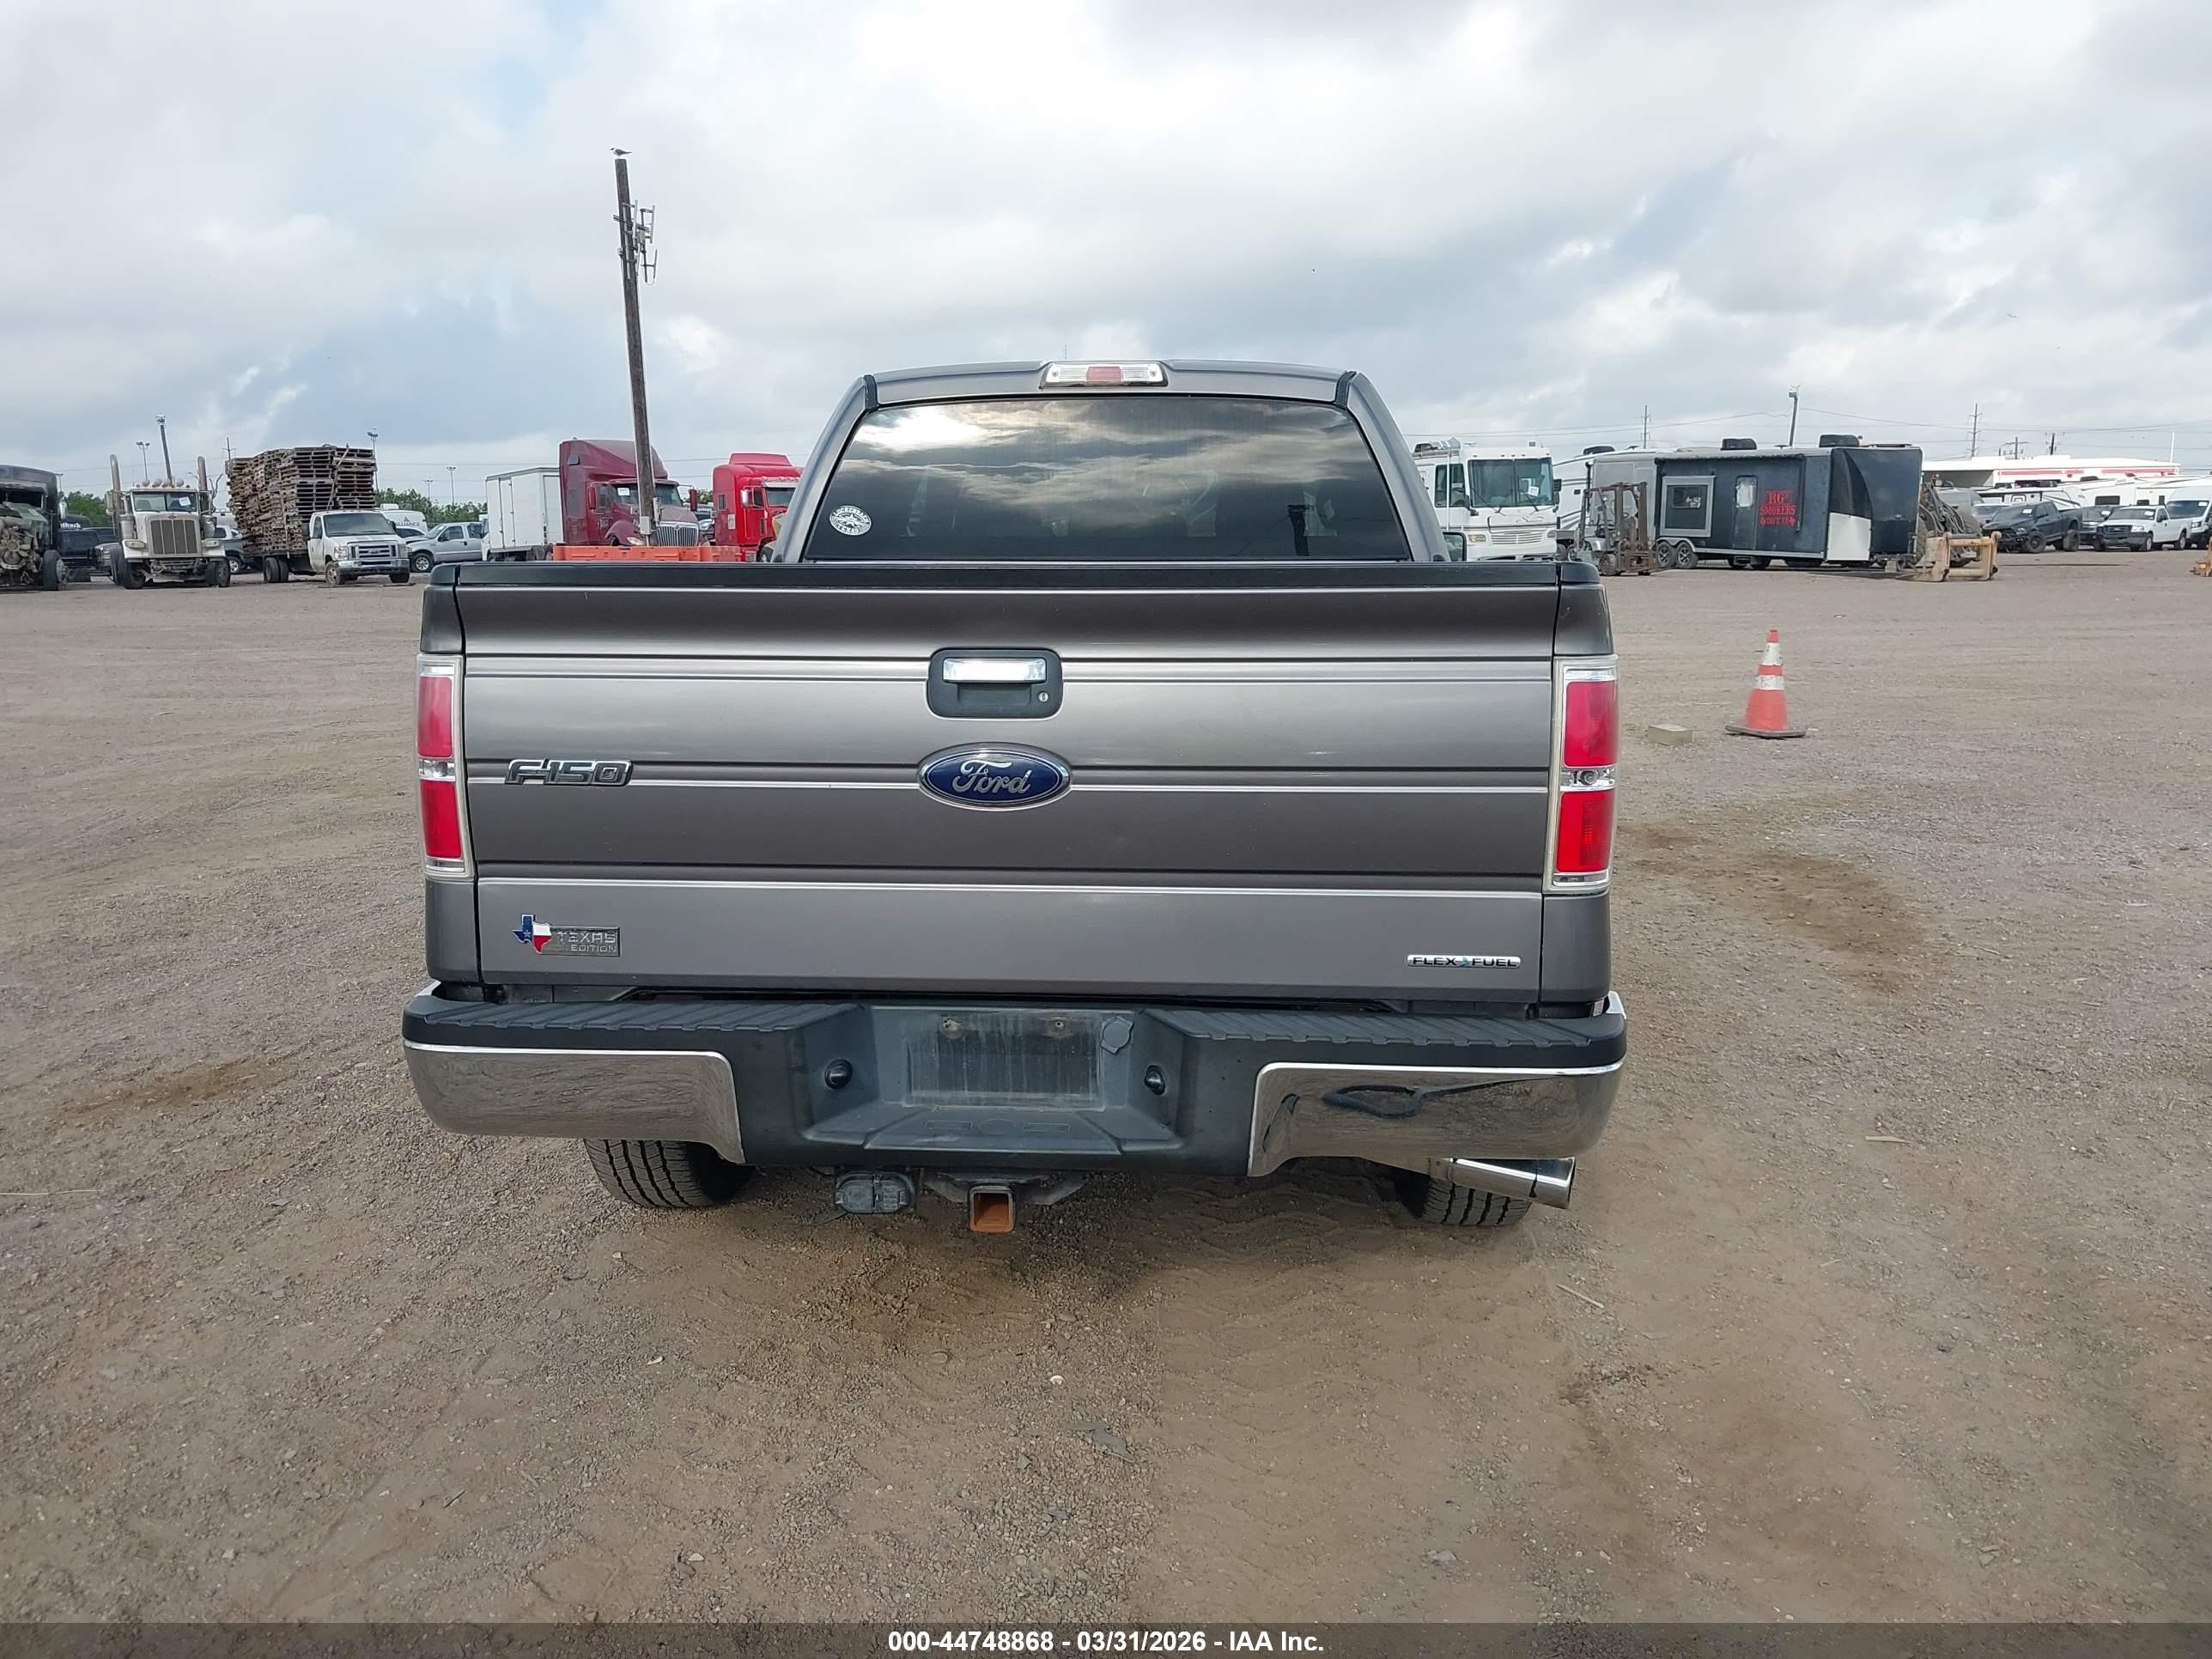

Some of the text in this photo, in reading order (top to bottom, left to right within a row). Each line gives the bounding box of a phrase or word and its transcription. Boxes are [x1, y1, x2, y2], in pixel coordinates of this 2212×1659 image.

[1760, 505, 1796, 516] SMOKERS
[837, 523, 860, 534] TEXAS
[952, 759, 1032, 794] Ford
[556, 931, 617, 944] TEXAS
[570, 944, 617, 953] EDITION
[1413, 957, 1517, 967] FLEX FUEL
